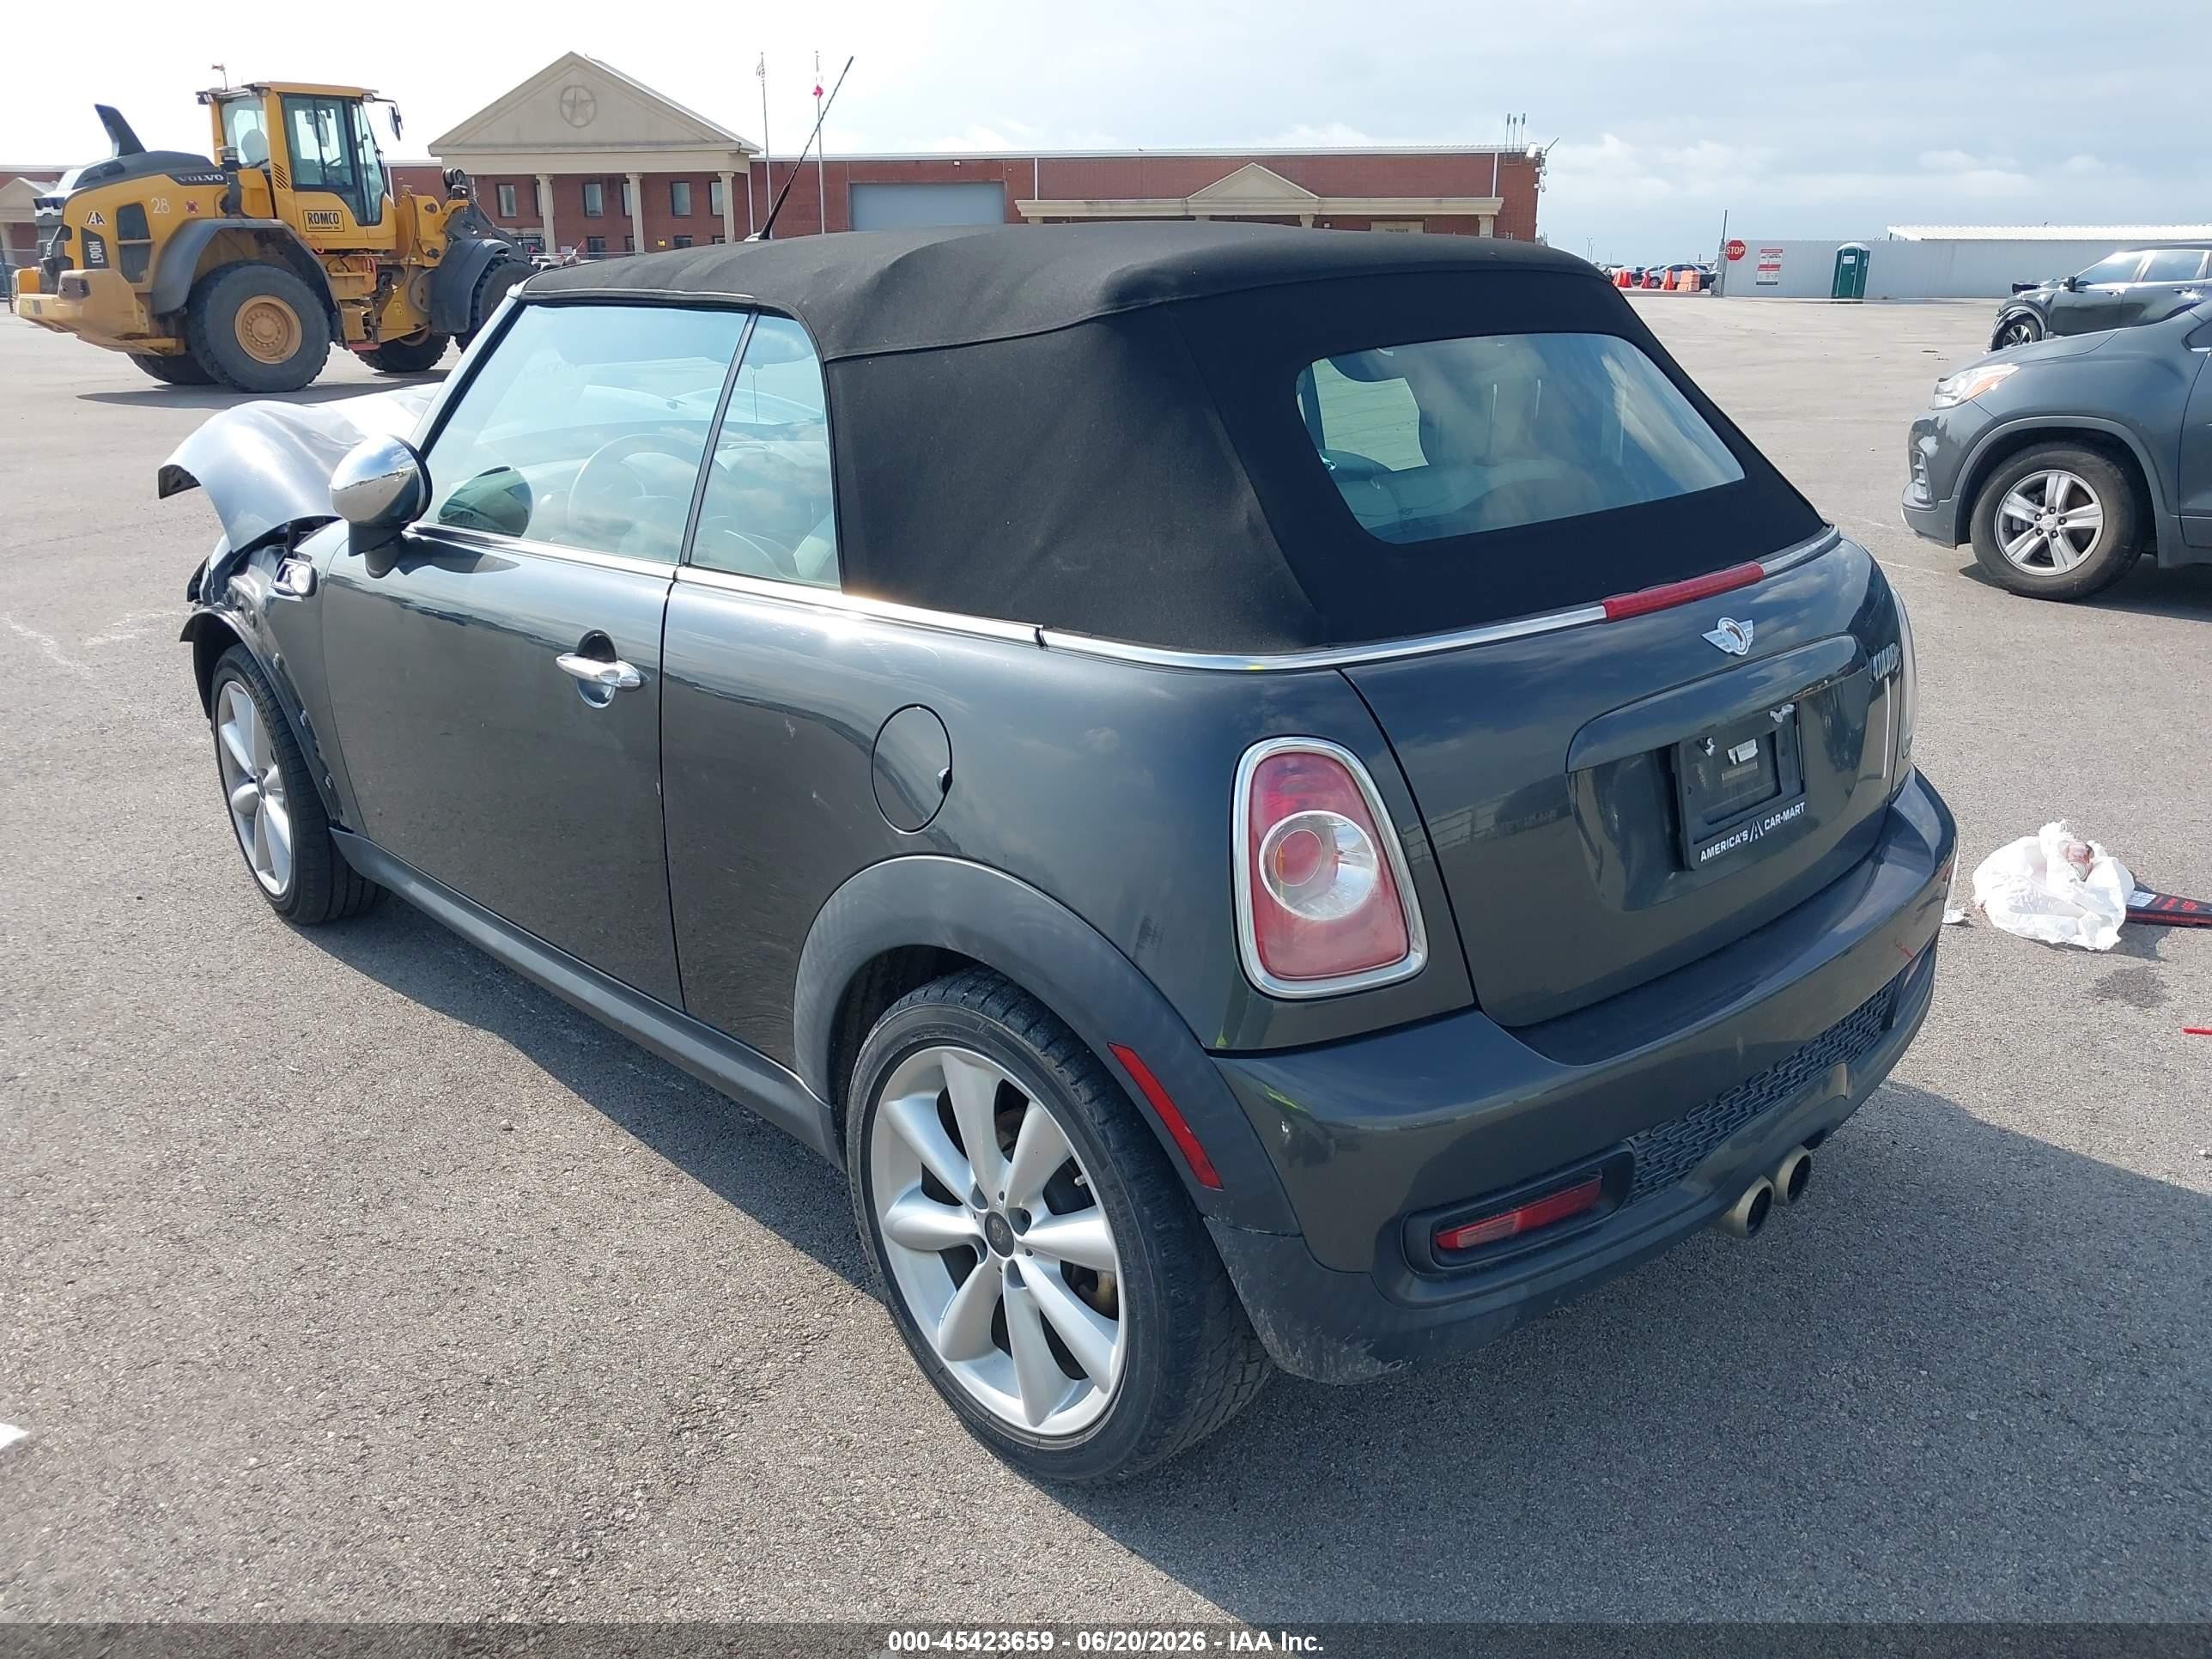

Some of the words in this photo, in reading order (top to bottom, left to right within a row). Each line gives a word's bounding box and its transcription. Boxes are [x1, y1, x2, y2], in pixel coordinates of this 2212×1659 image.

[178, 173, 224, 182] VOLVO
[150, 198, 170, 214] 28
[307, 212, 340, 225] ROMCO
[88, 240, 104, 264] L90H
[1726, 246, 1745, 255] STOP
[1700, 829, 1749, 863] AMERICA'S
[1763, 801, 1805, 831] CAR-MART
